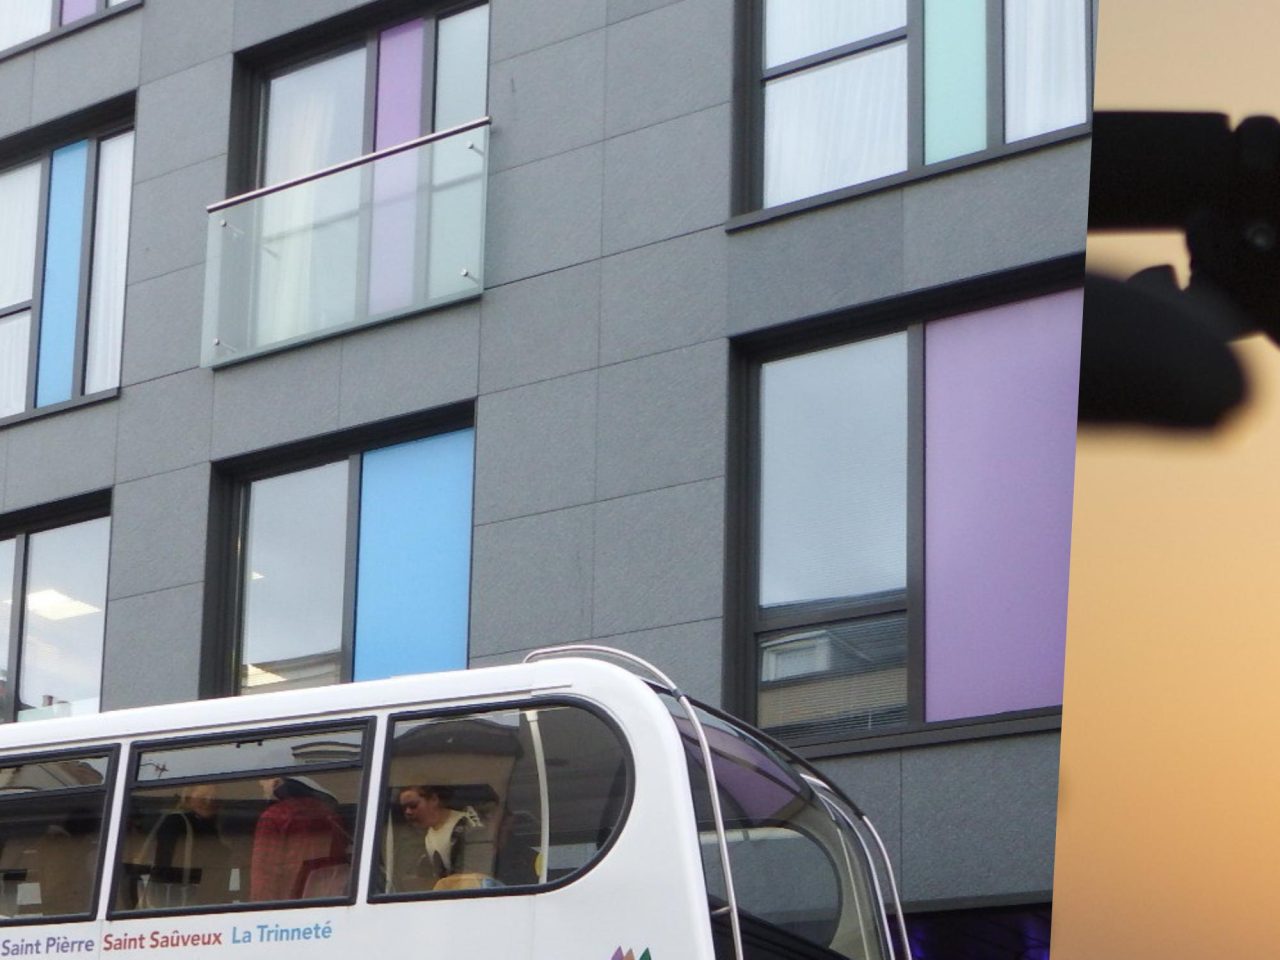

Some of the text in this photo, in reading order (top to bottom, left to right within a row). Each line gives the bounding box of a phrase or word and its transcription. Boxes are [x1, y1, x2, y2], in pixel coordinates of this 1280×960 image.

[103, 930, 222, 951] Saint Saûveux
[231, 920, 333, 944] La Trinneté
[1, 935, 95, 956] Saint Pièrre
